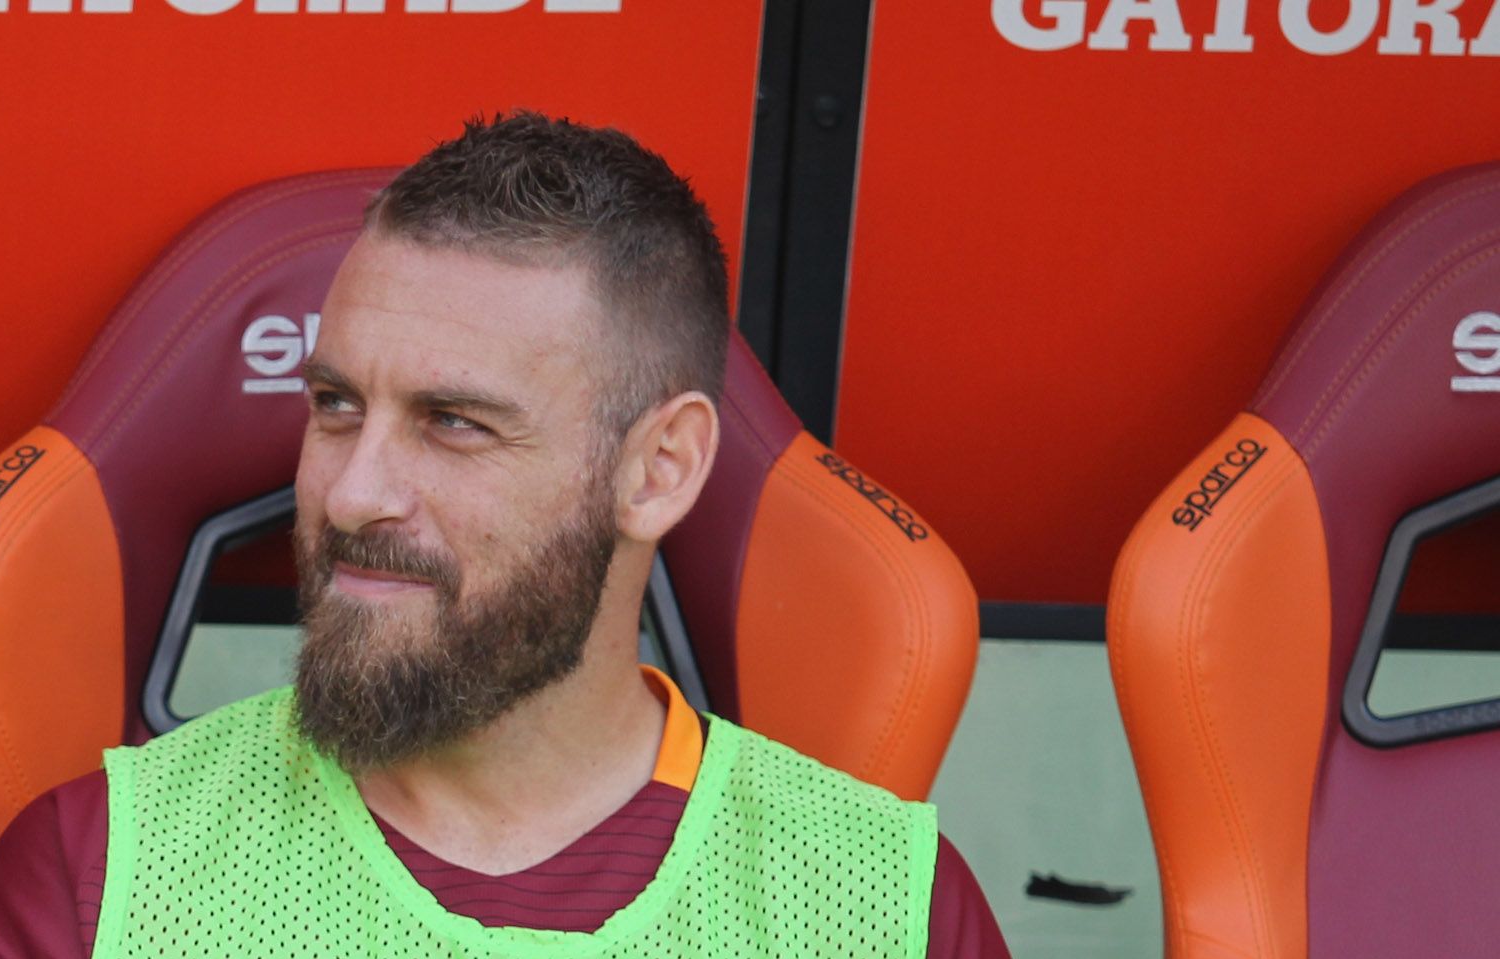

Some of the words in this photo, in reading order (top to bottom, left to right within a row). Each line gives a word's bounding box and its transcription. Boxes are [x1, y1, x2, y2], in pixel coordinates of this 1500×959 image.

[990, 0, 1500, 56] GATOR
[815, 454, 928, 542] sparco
[1170, 438, 1268, 532] sparco
